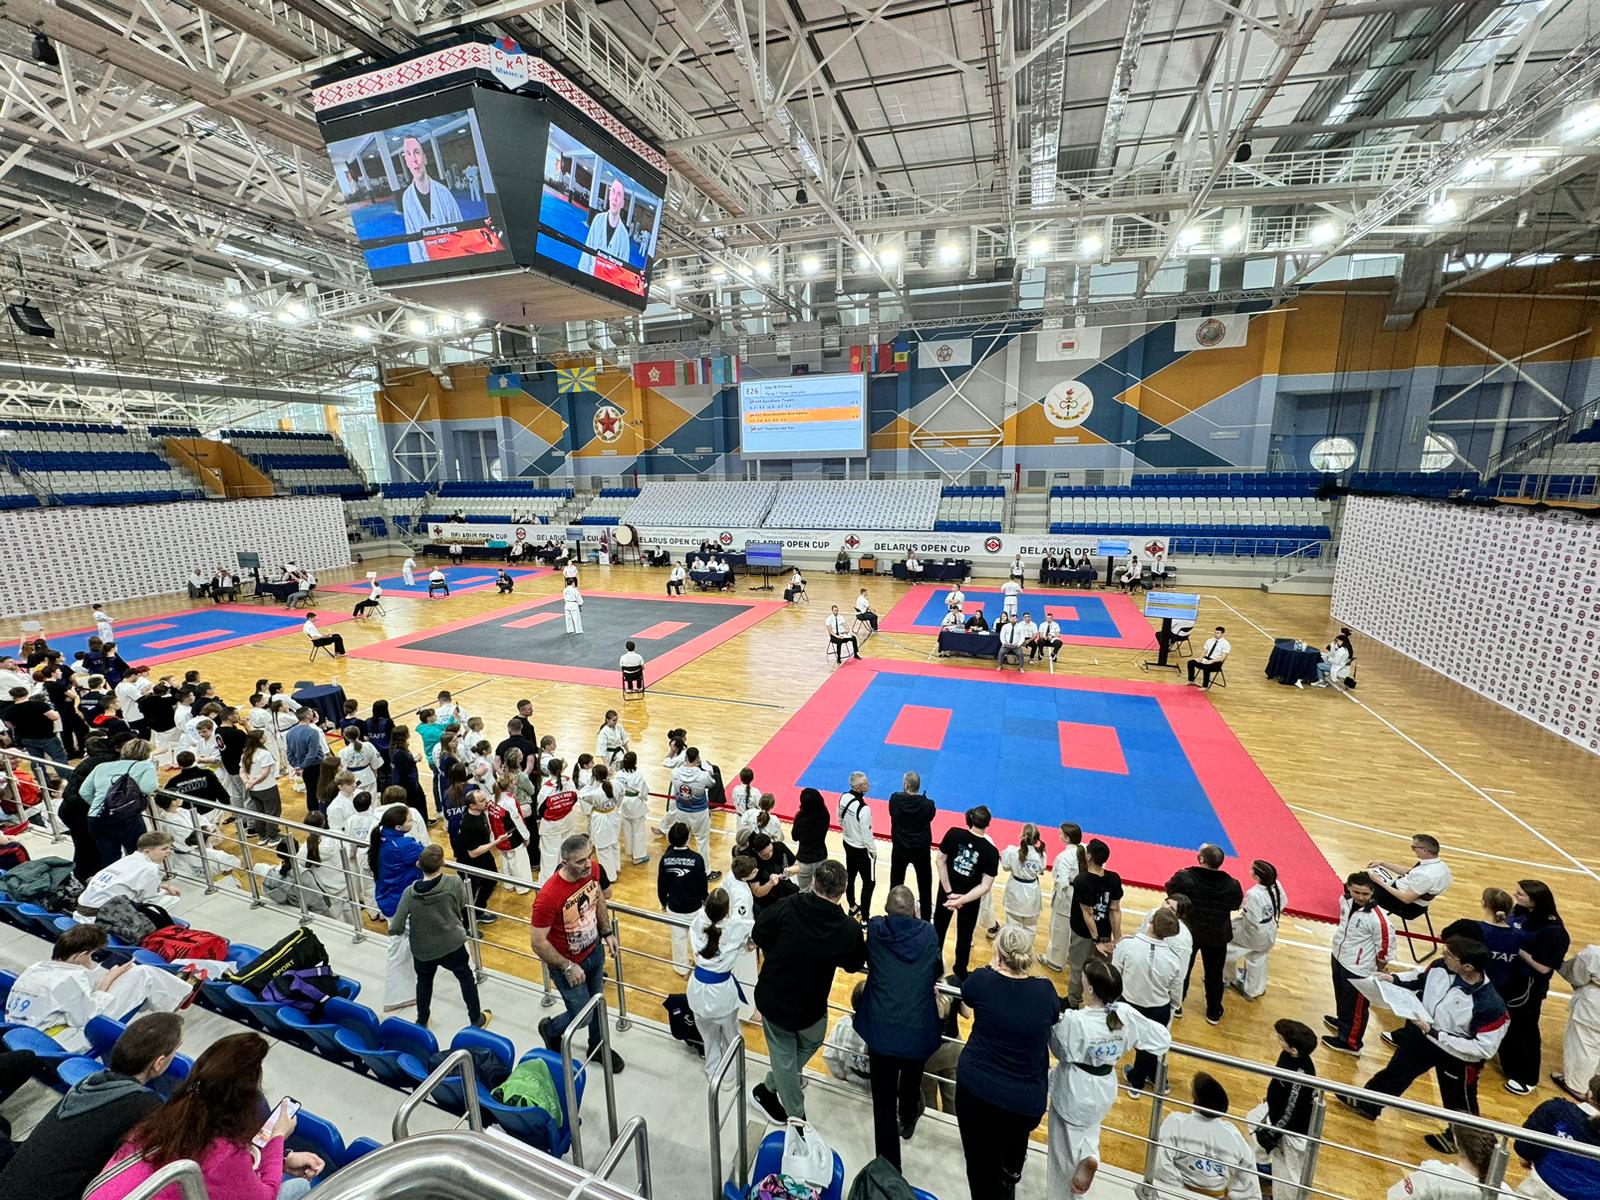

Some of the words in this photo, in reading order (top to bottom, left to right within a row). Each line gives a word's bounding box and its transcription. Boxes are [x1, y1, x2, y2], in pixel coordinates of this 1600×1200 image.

[495, 51, 523, 70] СКА
[495, 67, 525, 79] Минск
[639, 536, 668, 544] ELARUS
[787, 540, 810, 548] OPEN
[812, 541, 830, 549] CUP
[874, 543, 918, 551] BELARUS
[921, 544, 947, 552] OPEN
[950, 545, 970, 553] CUP
[1020, 546, 1071, 555] BELARUS
[1074, 547, 1096, 556] OPE
[446, 805, 467, 817] STAF
[1490, 951, 1518, 962] TAF
